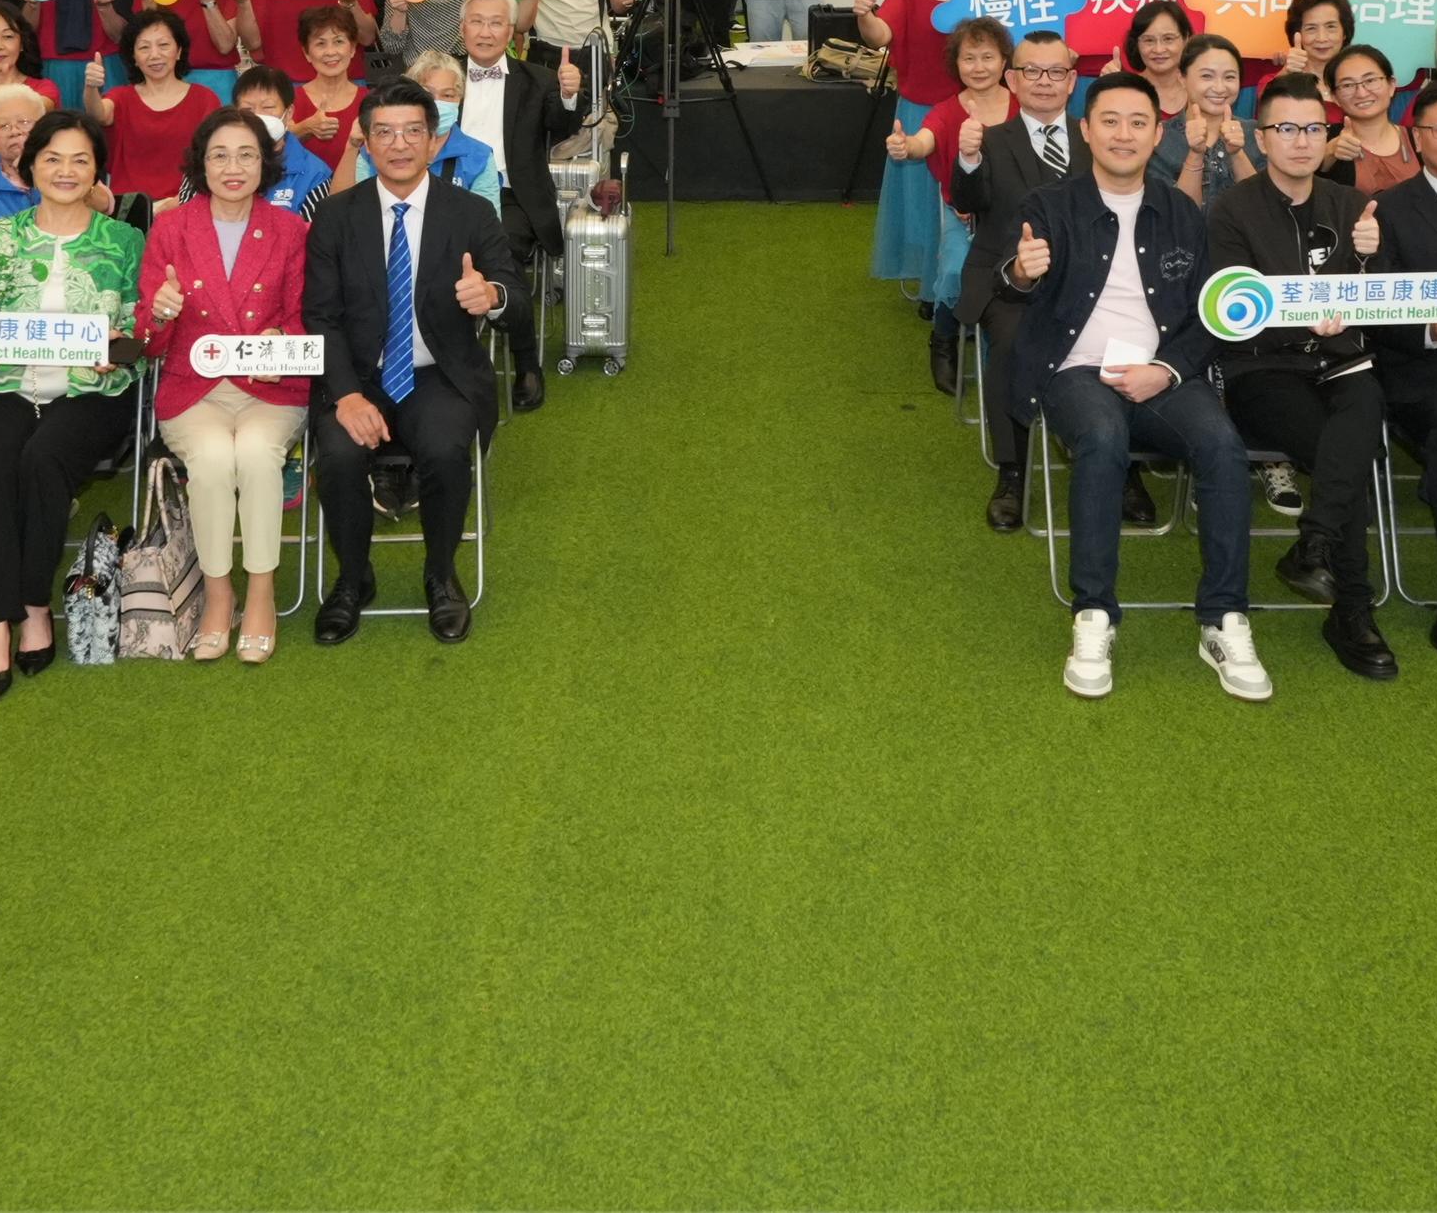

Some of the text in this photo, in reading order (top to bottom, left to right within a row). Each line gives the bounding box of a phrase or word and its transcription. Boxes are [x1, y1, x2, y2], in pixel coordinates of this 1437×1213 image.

[1280, 309, 1319, 322] Tsuen
[1355, 305, 1404, 320] District
[12, 346, 55, 360] Health
[58, 347, 103, 361] Centre
[235, 339, 321, 361] 仁濟醫院
[235, 361, 320, 374] Yan Chai Hospital
